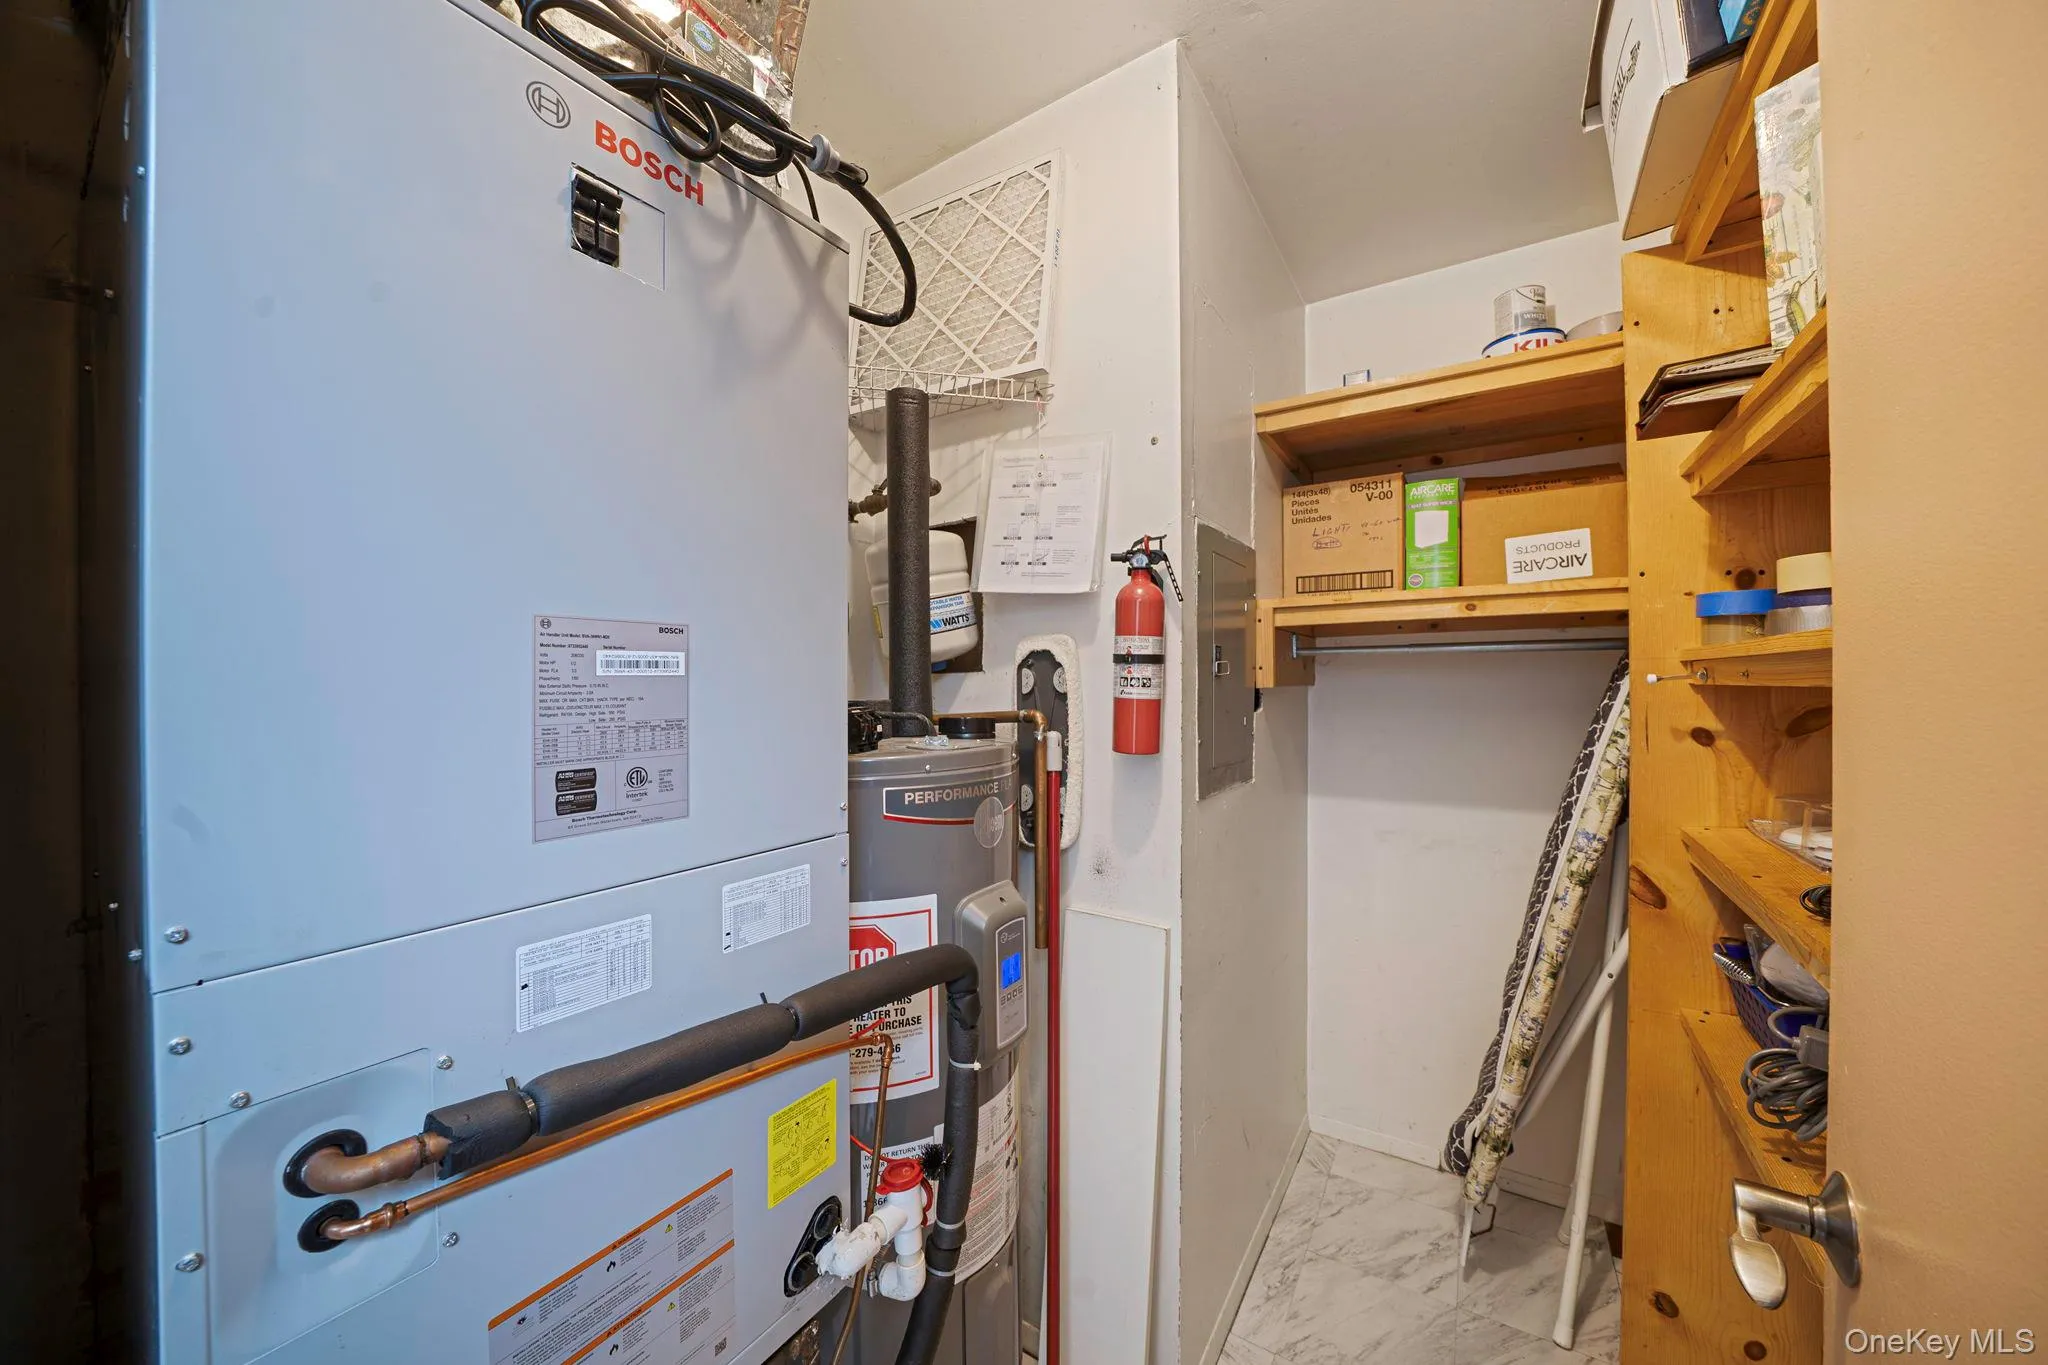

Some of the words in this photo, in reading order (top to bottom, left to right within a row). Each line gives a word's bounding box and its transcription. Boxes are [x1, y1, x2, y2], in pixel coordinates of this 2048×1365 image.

[595, 119, 704, 206] BOSCH
[1292, 487, 1331, 499] 144(3x48)
[1350, 480, 1392, 493] 054311
[1366, 490, 1393, 502] V-00
[1410, 483, 1455, 500] AIRCARE
[1291, 498, 1320, 508] Pieces
[1291, 507, 1319, 516] Unités
[1291, 514, 1332, 525] Unidades
[1515, 539, 1580, 555] PRODUCTS
[1513, 552, 1588, 574] AIRCARE
[942, 613, 970, 627] WATTS
[658, 626, 684, 634] BOSCH
[626, 791, 648, 799] Intertek
[904, 781, 999, 805] PERFORMANCE
[849, 947, 888, 971] TOP
[854, 1010, 891, 1022] HEATER
[894, 1007, 906, 1017] TO
[873, 1015, 922, 1032] URCHASE
[891, 1146, 916, 1157] RETURN
